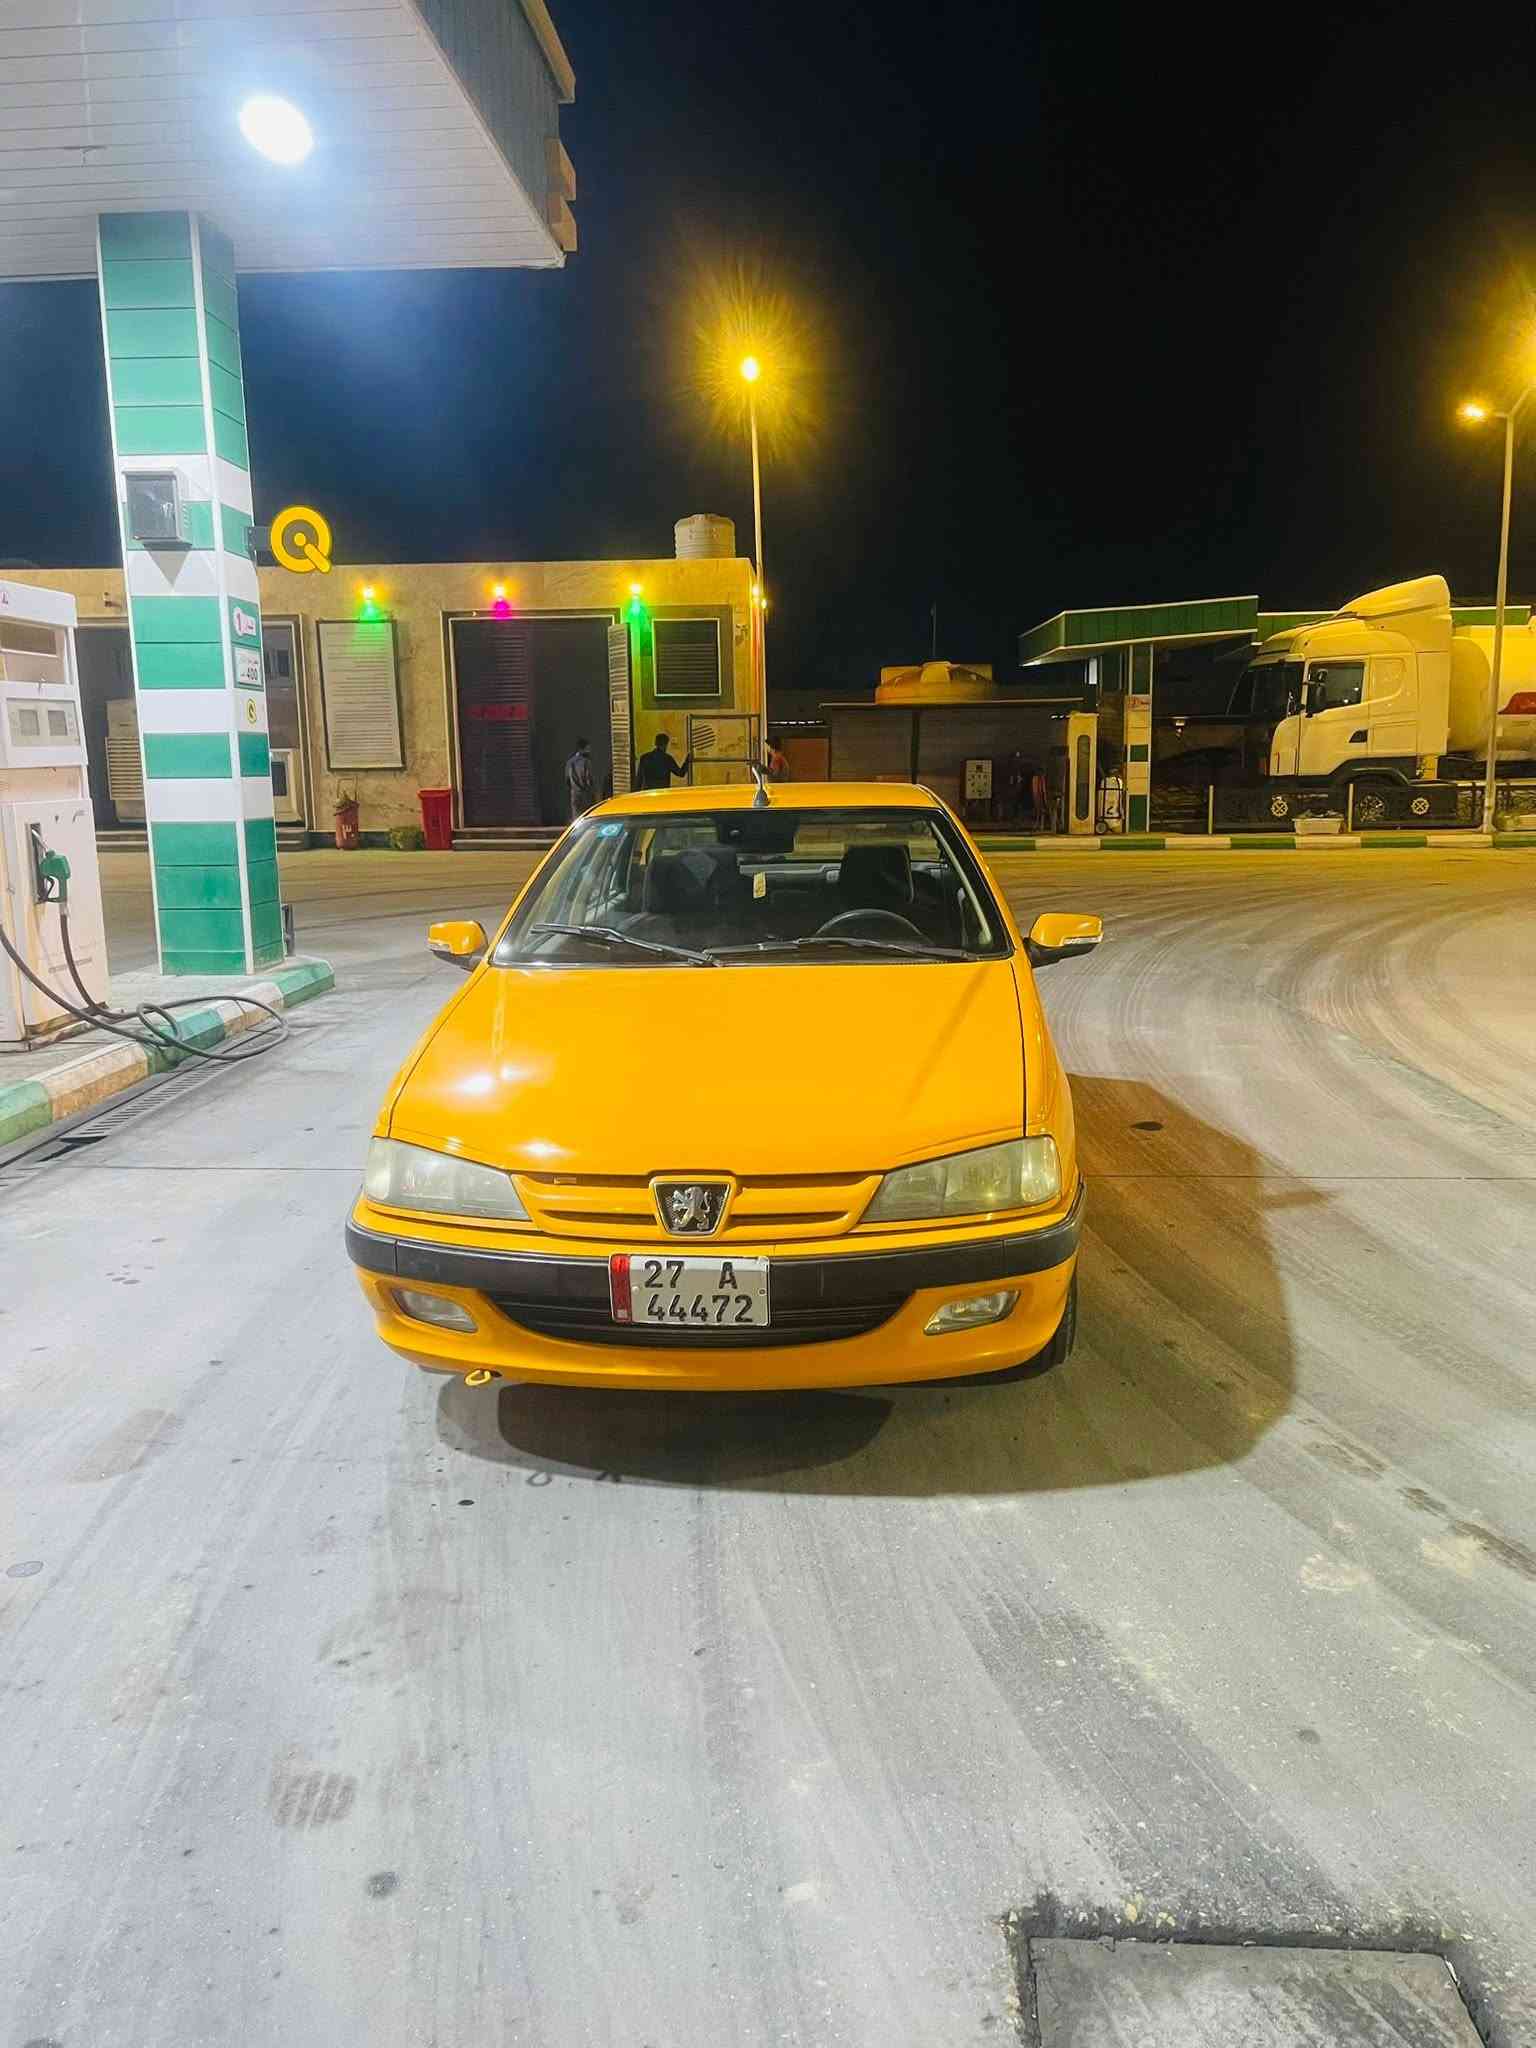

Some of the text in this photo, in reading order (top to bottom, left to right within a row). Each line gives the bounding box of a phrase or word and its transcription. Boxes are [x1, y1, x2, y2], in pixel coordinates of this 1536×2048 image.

[644, 1260, 685, 1289] 27
[718, 1261, 738, 1290] A
[647, 1293, 753, 1323] 44472
